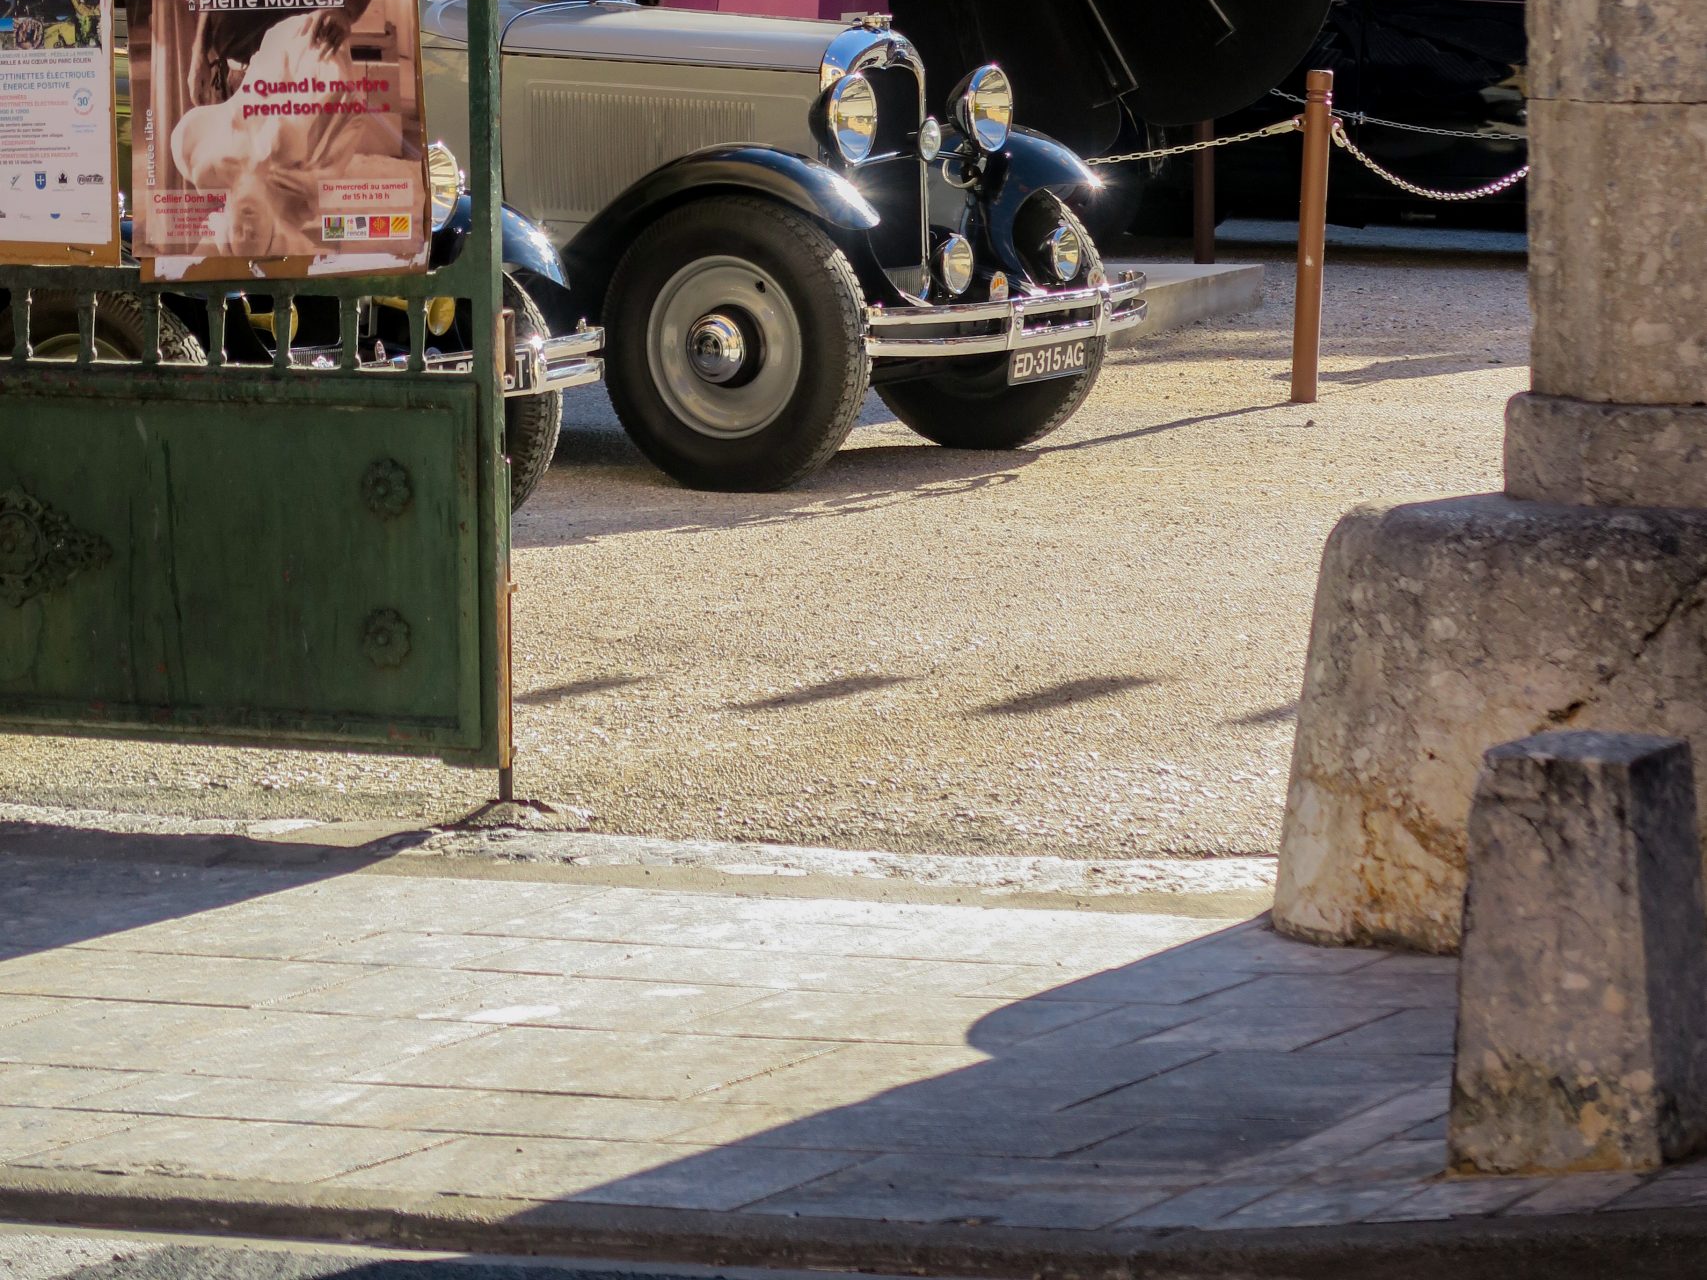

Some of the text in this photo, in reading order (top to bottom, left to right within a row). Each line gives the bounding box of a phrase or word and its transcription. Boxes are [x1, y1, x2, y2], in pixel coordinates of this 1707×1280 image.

[37, 81, 70, 89] POSITIVE
[254, 78, 309, 97] Quand
[312, 77, 327, 93] le
[330, 76, 390, 93] marbre
[242, 99, 292, 120] prend
[144, 108, 157, 187] Entrée Libre
[323, 182, 409, 192] Du mercredi au samedi
[154, 193, 226, 204] Cellier Dom Brial
[342, 192, 352, 201] de
[354, 192, 361, 201] 15
[375, 191, 384, 199] 18
